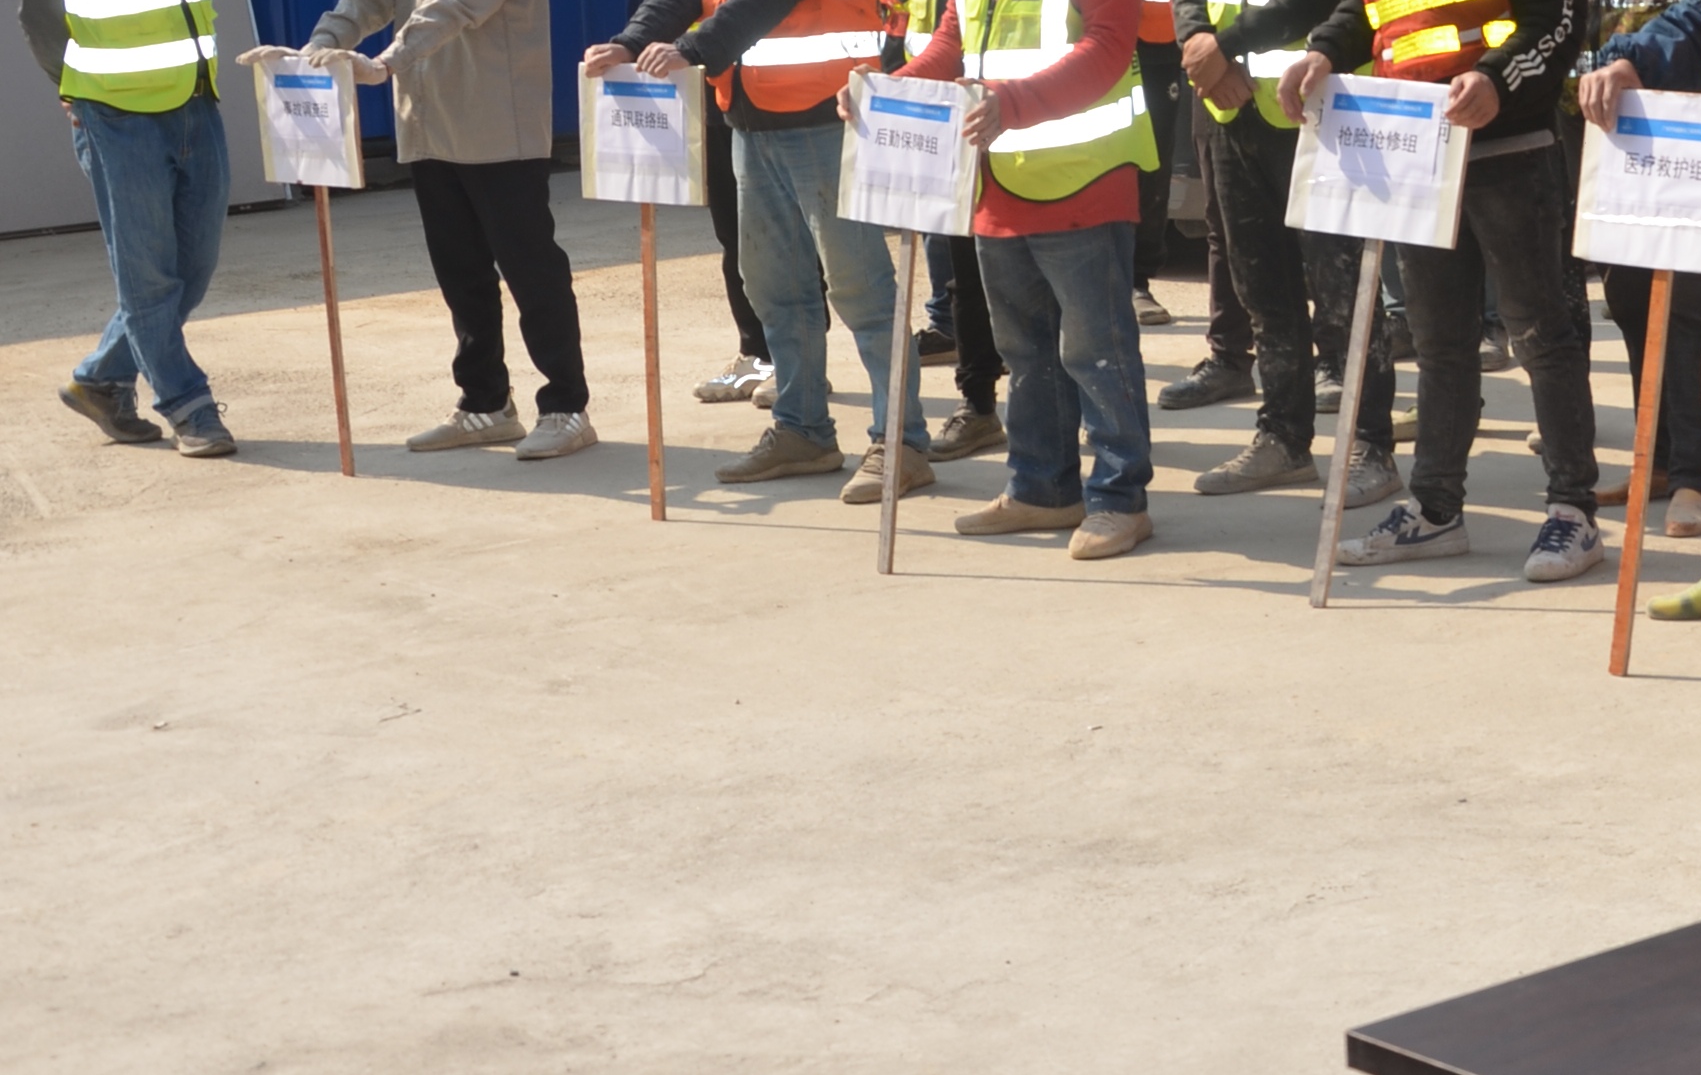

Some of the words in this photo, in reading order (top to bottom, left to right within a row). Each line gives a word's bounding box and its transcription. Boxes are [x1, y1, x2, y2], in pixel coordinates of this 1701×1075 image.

[875, 128, 938, 155] 后勤保障组
[1338, 125, 1418, 153] 抢险抢修组
